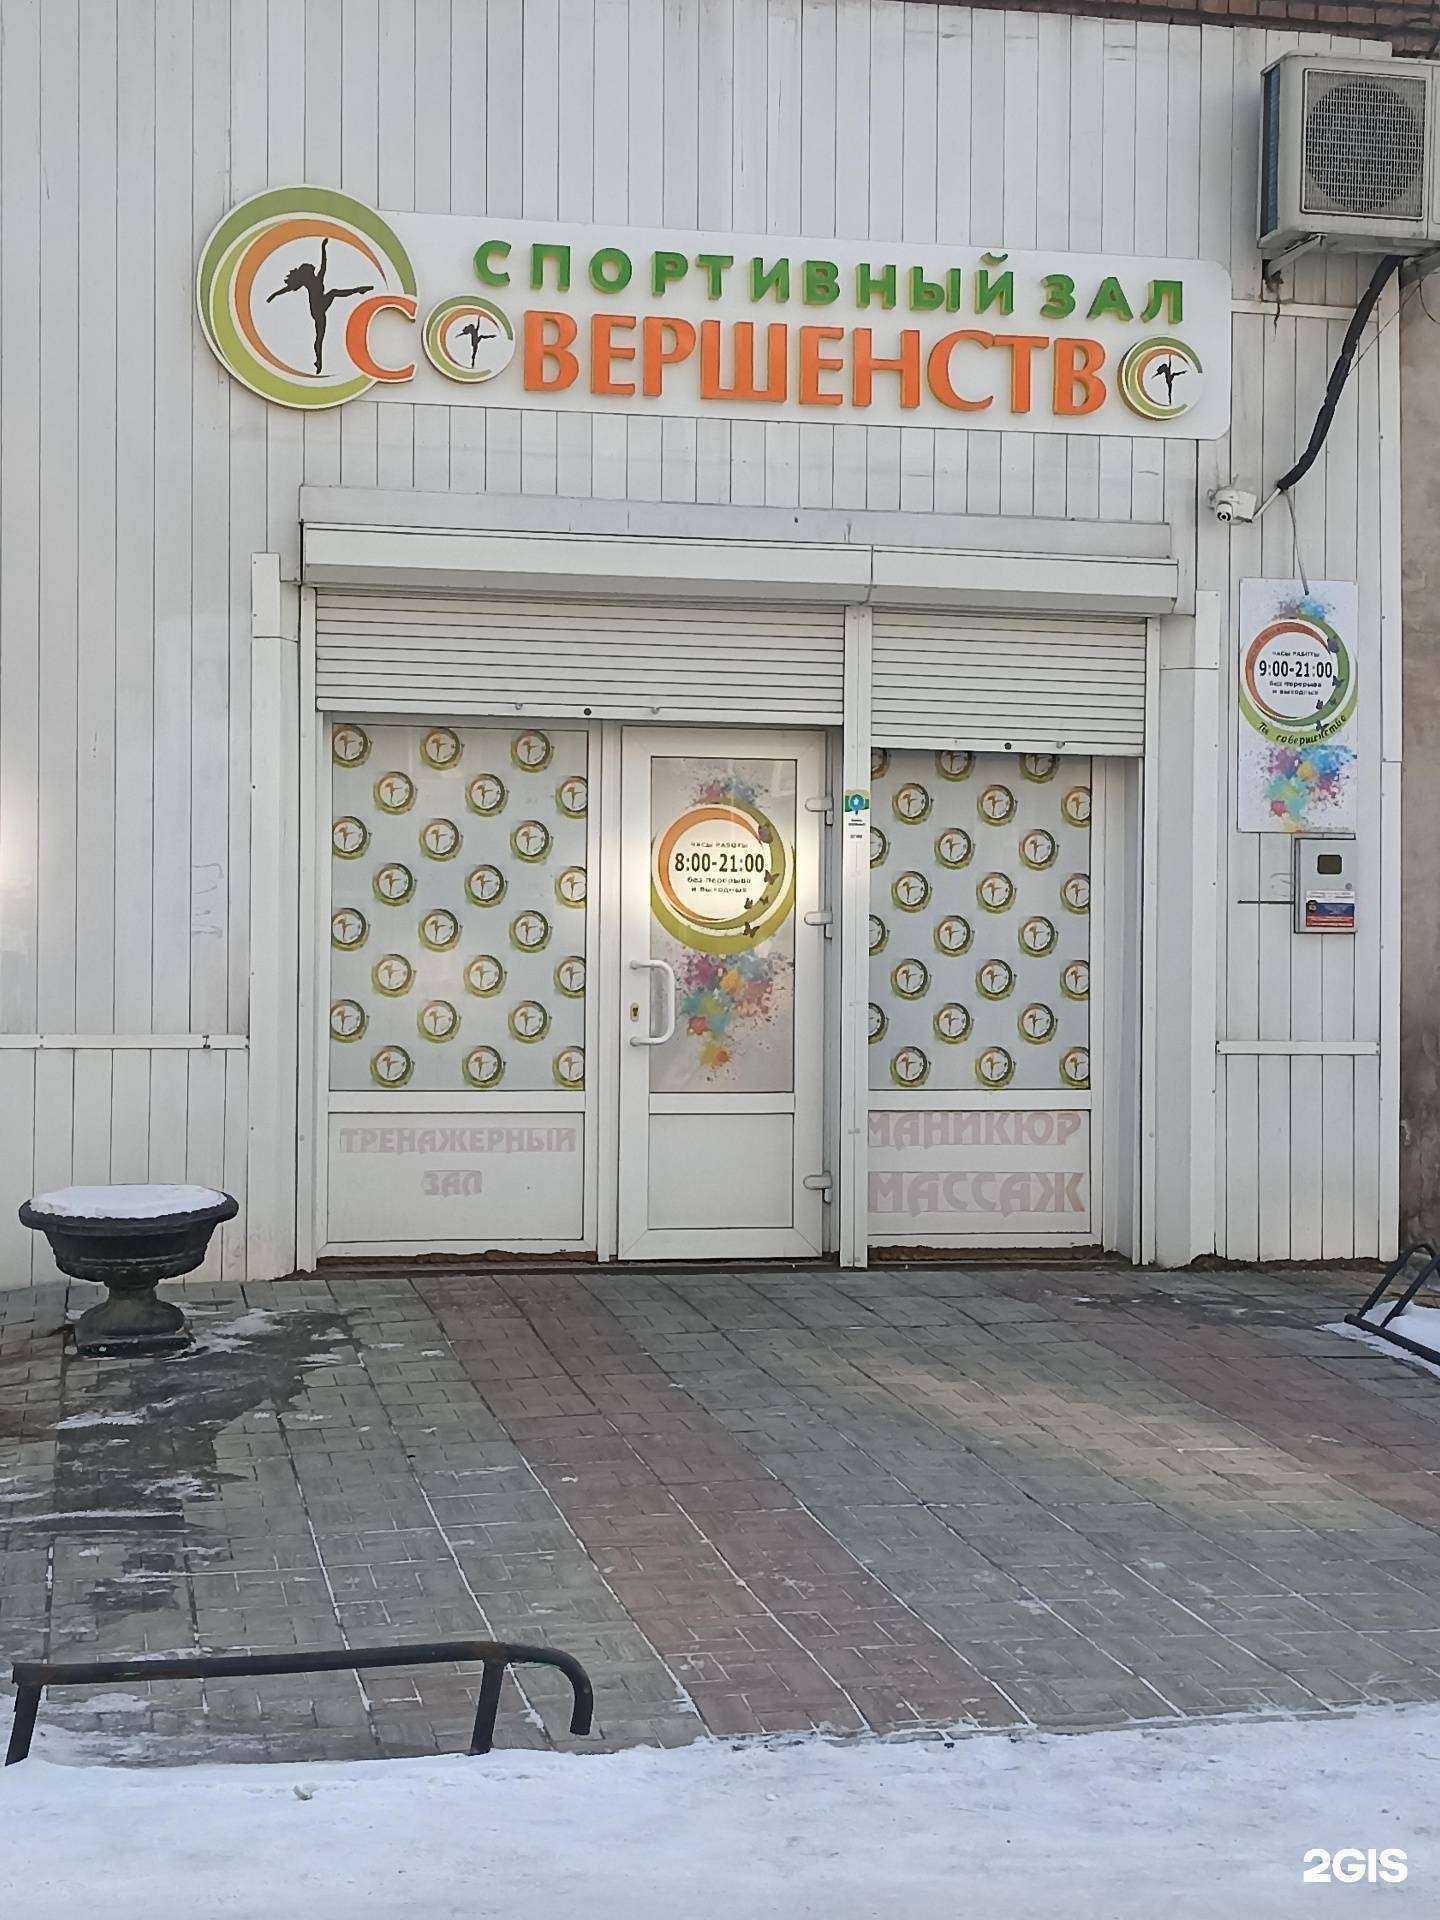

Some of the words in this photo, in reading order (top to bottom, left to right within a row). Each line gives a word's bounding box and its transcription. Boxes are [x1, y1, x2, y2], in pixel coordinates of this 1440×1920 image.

[473, 240, 1014, 316] СПОРТИВНЫЙ
[1040, 273, 1184, 325] ЗАЛ
[1258, 660, 1333, 679] 9:00-21:00
[674, 852, 765, 873] 8:00-21:00
[868, 1111, 1083, 1149] МАНИКЮР
[420, 1170, 482, 1198] ЗАЛ
[868, 1171, 1086, 1218] МАССАЖ
